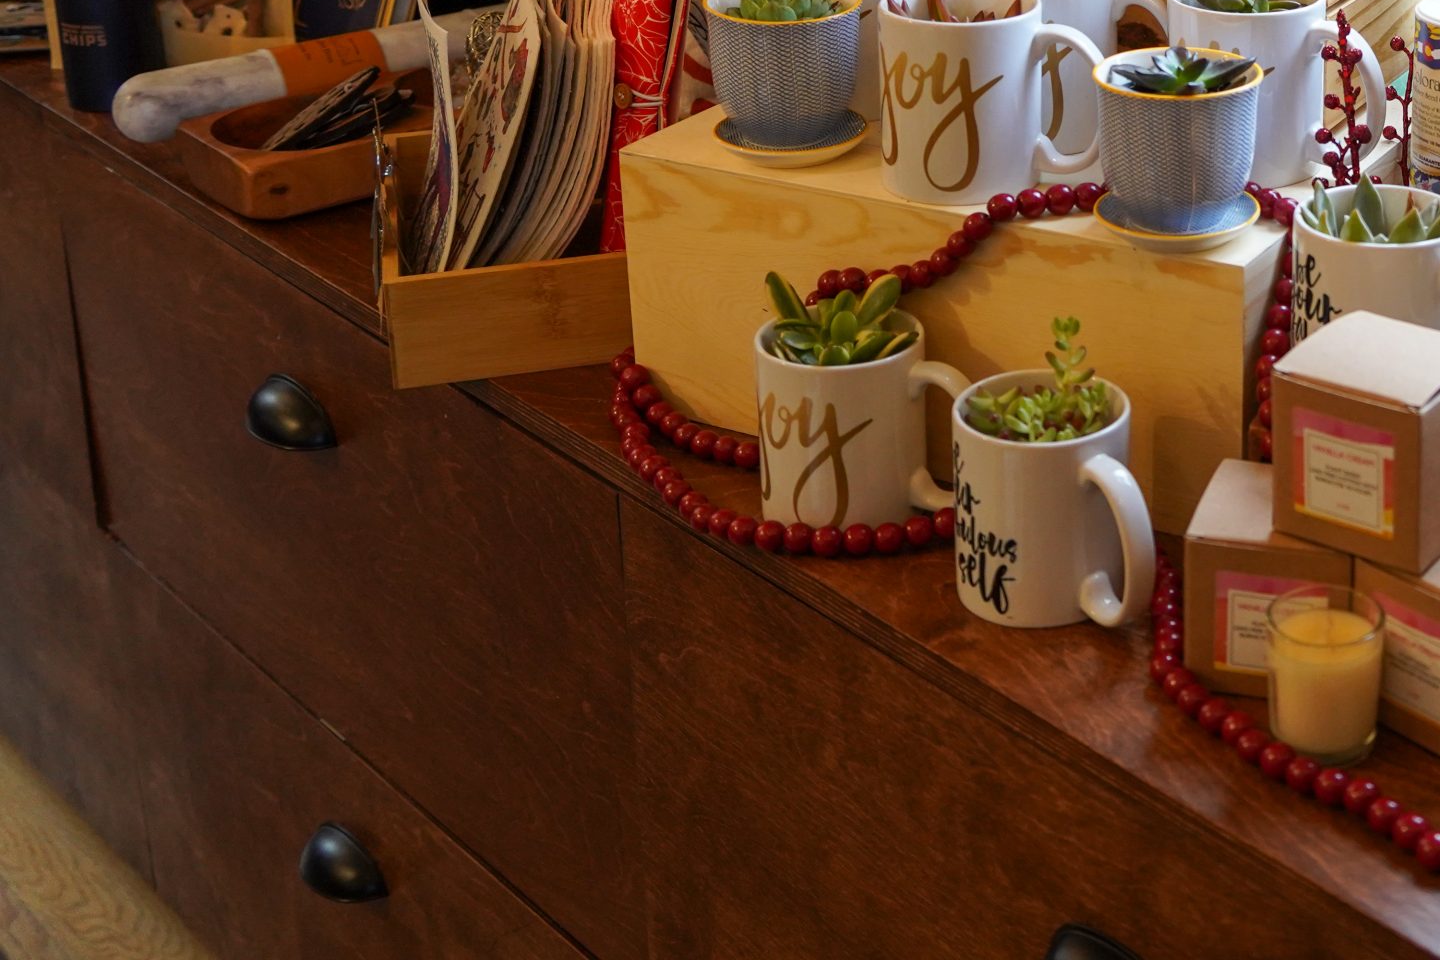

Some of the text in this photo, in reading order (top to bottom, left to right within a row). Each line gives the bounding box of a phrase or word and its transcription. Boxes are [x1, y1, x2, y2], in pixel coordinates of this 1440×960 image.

[62, 30, 108, 47] CHIPS
[880, 40, 1005, 193] joy
[1296, 251, 1322, 288] be
[1292, 286, 1342, 325] our
[959, 552, 1017, 614] self
